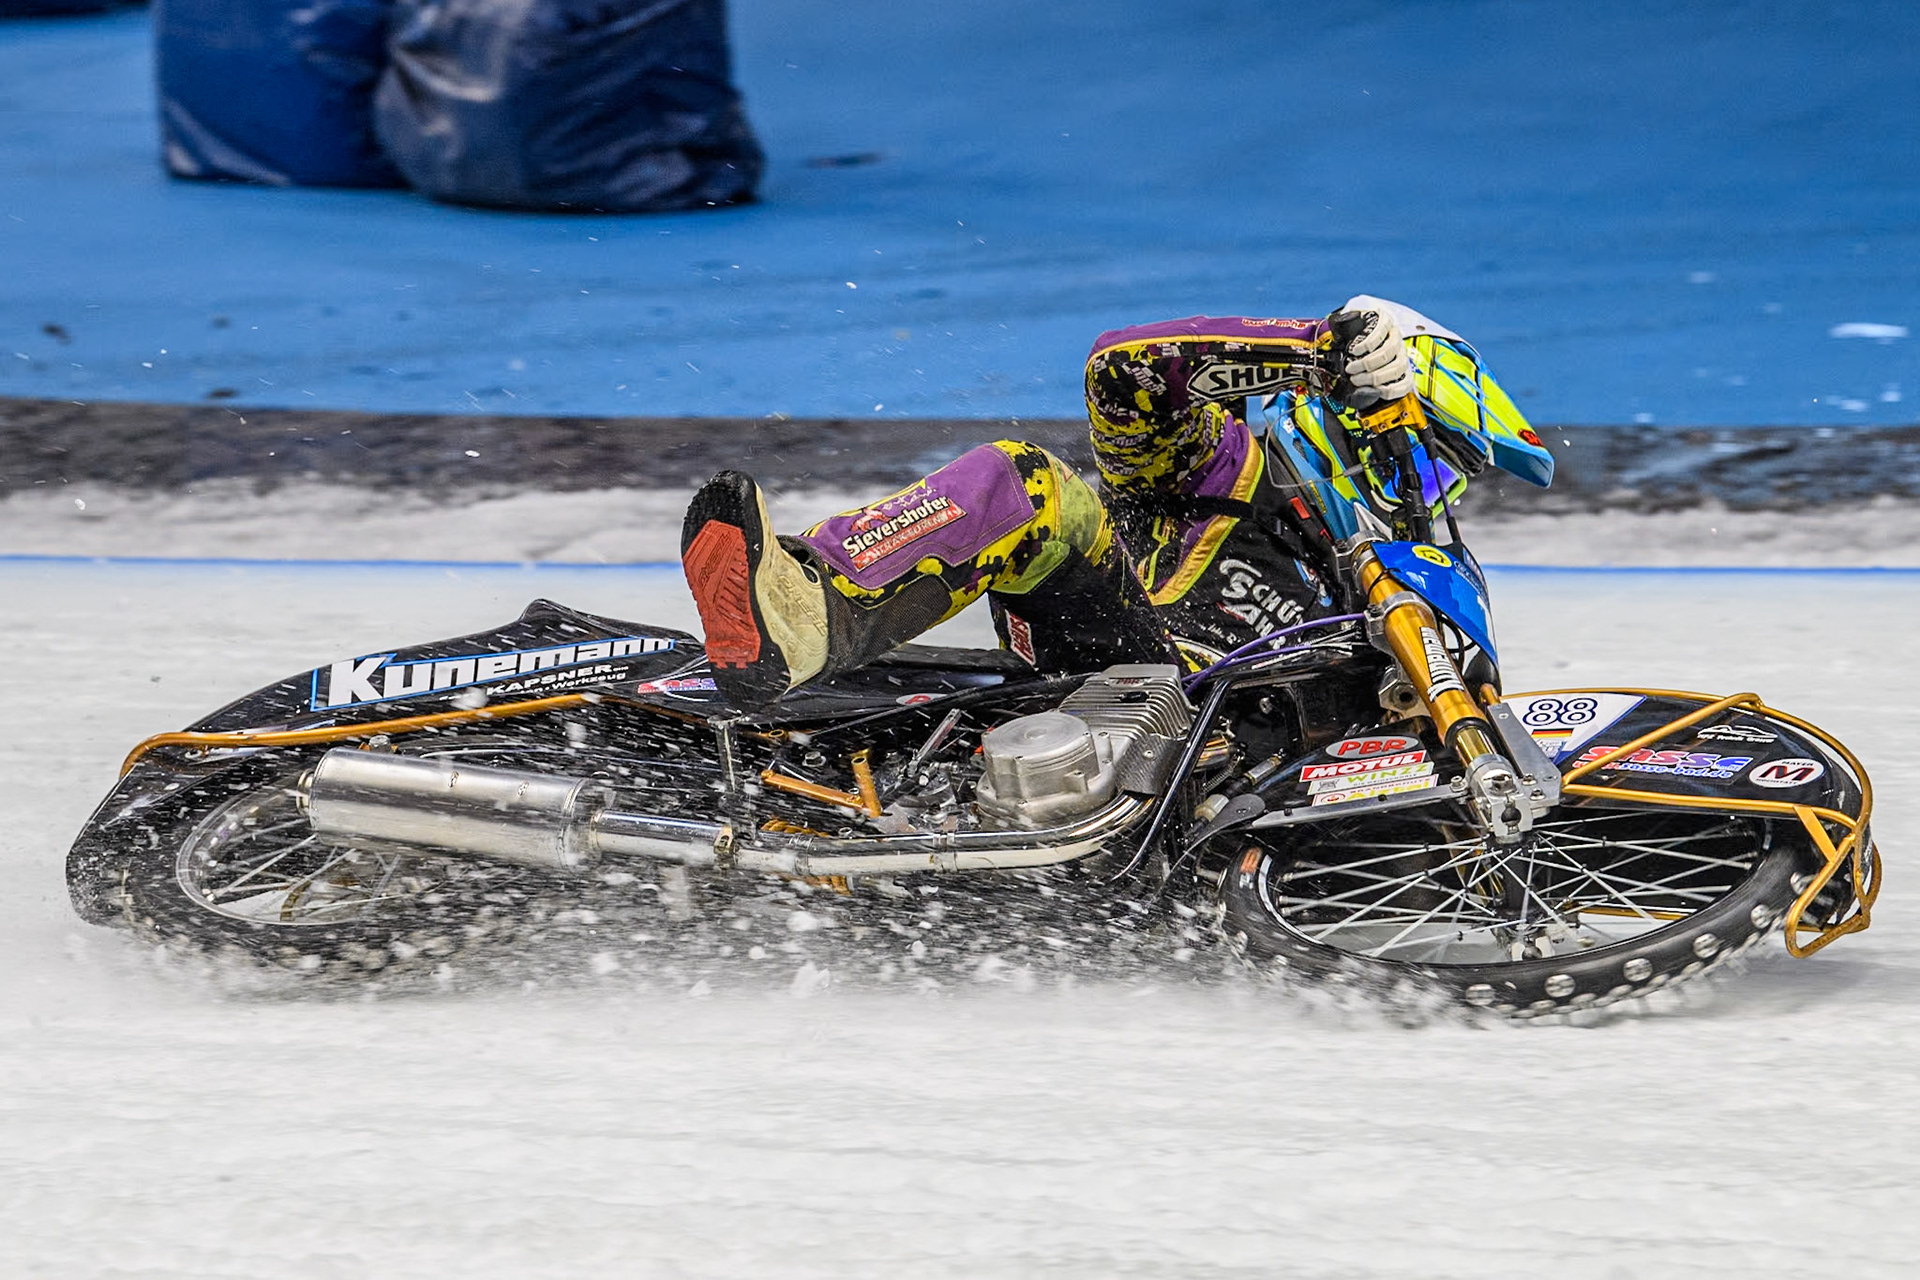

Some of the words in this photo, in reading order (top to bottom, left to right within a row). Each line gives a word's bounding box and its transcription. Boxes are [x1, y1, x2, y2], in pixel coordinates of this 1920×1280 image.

[842, 496, 948, 558] Sievershofer
[327, 638, 673, 707] Kunemann
[487, 663, 612, 695] KAPSNER
[552, 671, 626, 691] Werkzeug
[1522, 697, 1598, 726] 88
[1338, 739, 1407, 756] PBR
[1308, 754, 1418, 779] MOTUL
[1347, 763, 1428, 783] WINZZ
[1759, 765, 1815, 781] M
